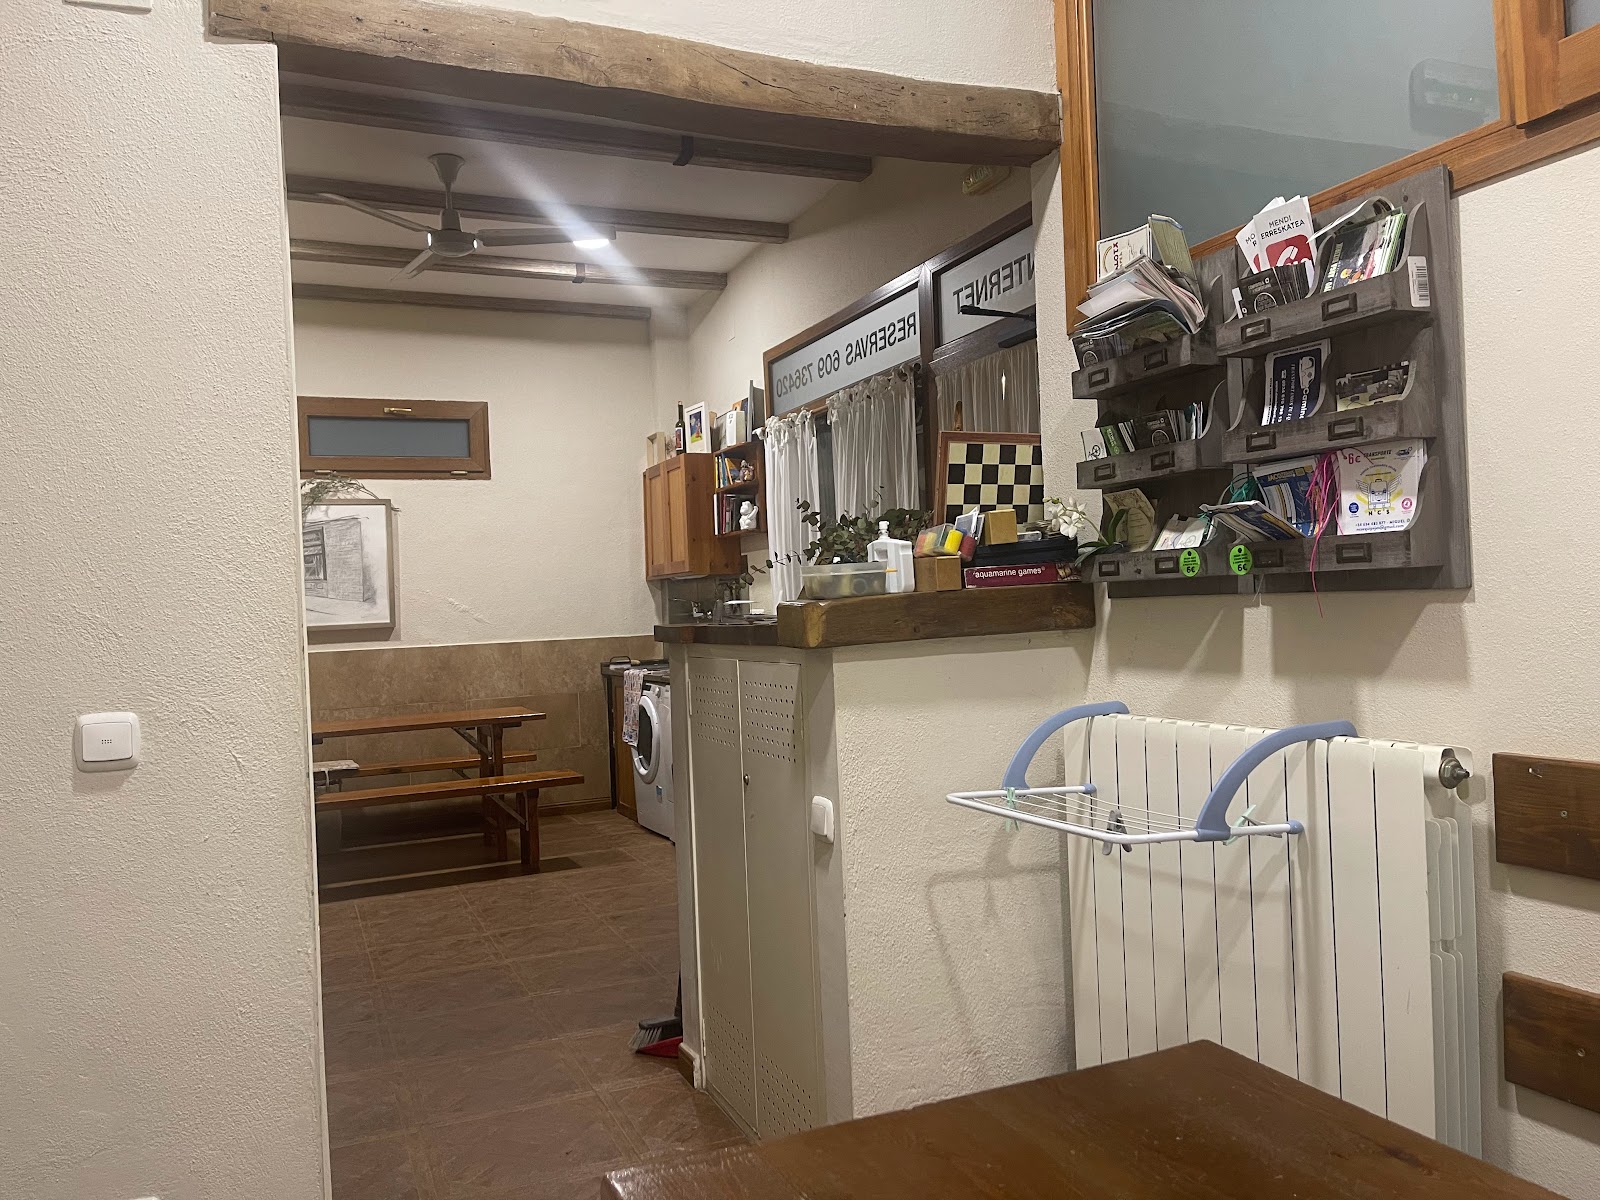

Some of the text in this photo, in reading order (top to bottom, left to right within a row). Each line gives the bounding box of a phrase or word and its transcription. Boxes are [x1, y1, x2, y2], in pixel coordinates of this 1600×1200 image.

[1268, 215, 1292, 229] MENDI
[1260, 219, 1305, 240] ERRESKATEA
[974, 569, 1017, 580] aquamarine
